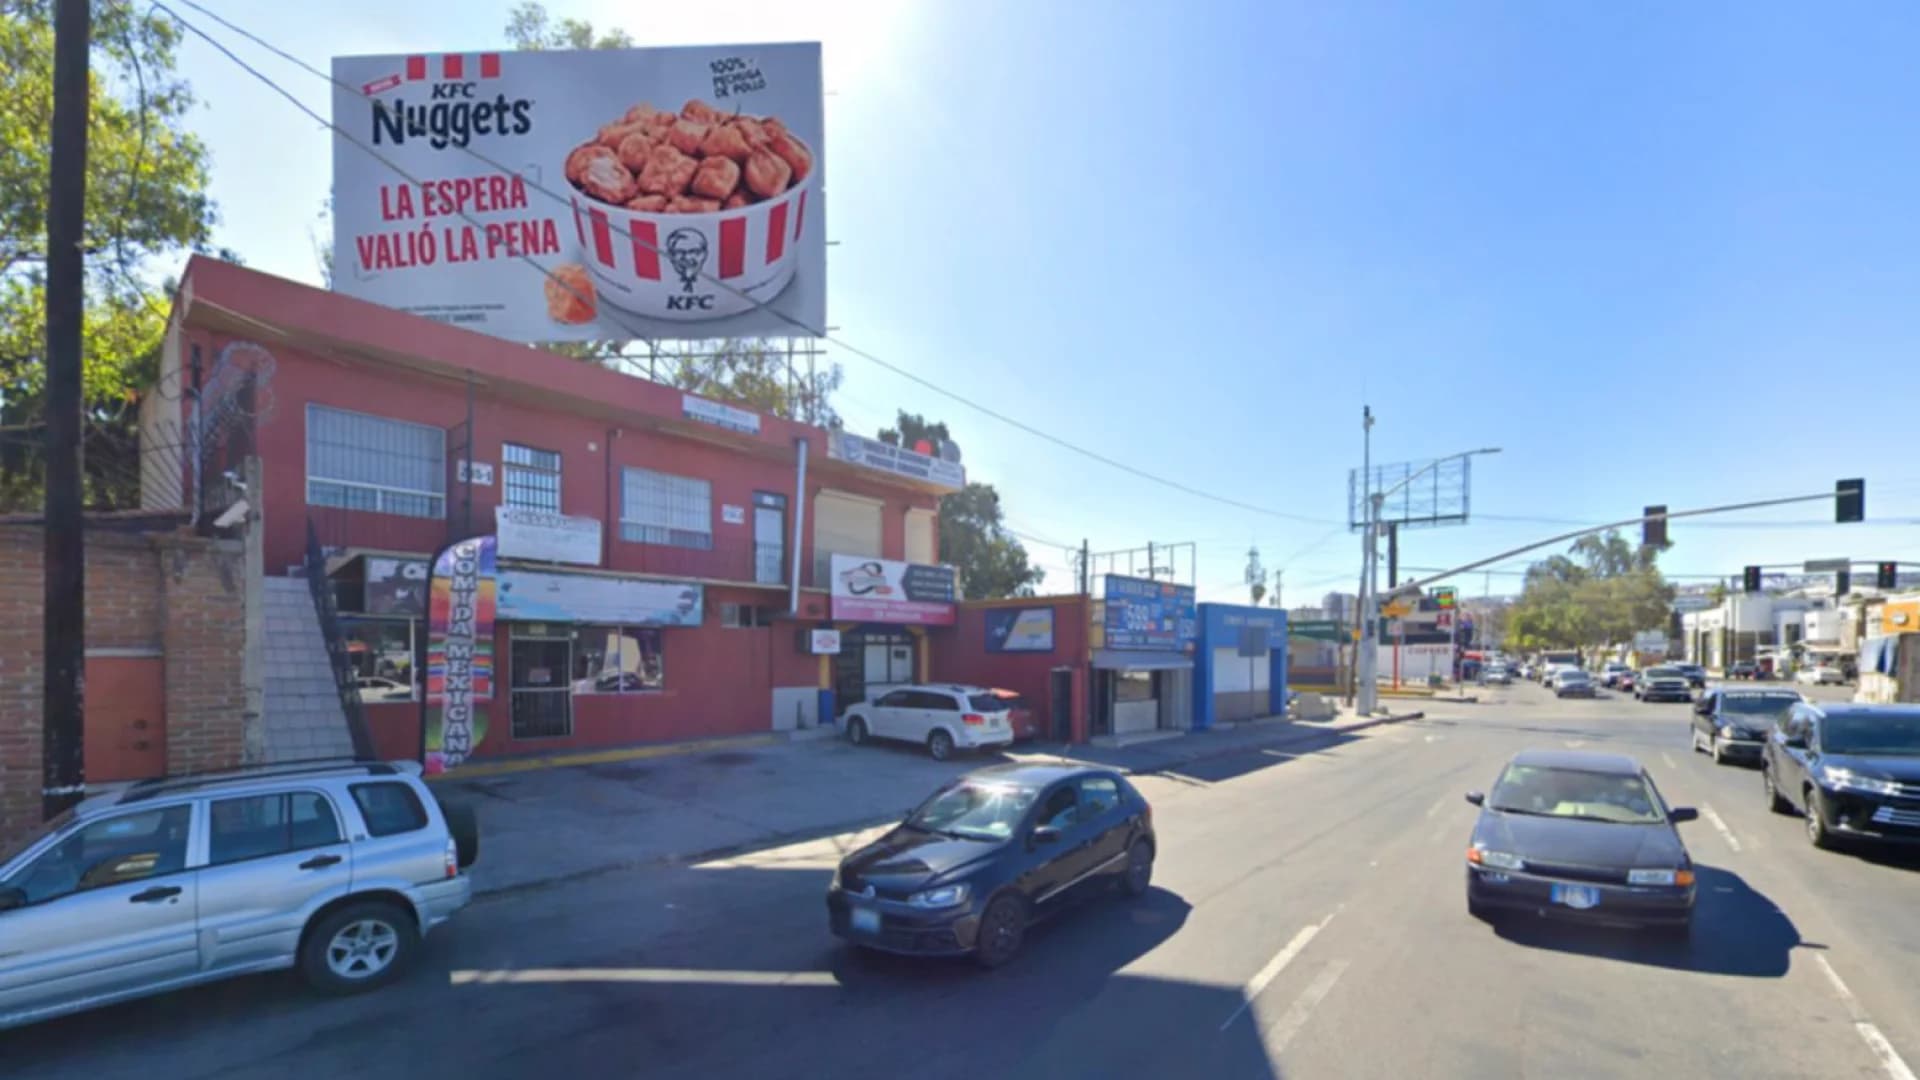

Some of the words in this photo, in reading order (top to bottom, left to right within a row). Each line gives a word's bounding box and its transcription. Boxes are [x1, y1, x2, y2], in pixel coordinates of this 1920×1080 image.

[430, 82, 477, 99] KFC
[710, 57, 746, 74] 100%
[372, 94, 531, 149] Nuggets
[381, 184, 414, 221] LA
[421, 174, 528, 217] ESPERA
[356, 222, 437, 271] VALIÓ
[445, 226, 479, 263] LA
[487, 218, 560, 259] PENA
[665, 295, 715, 310] KFC
[452, 544, 476, 636] COMIDA
[446, 643, 473, 765] MEXICANA
